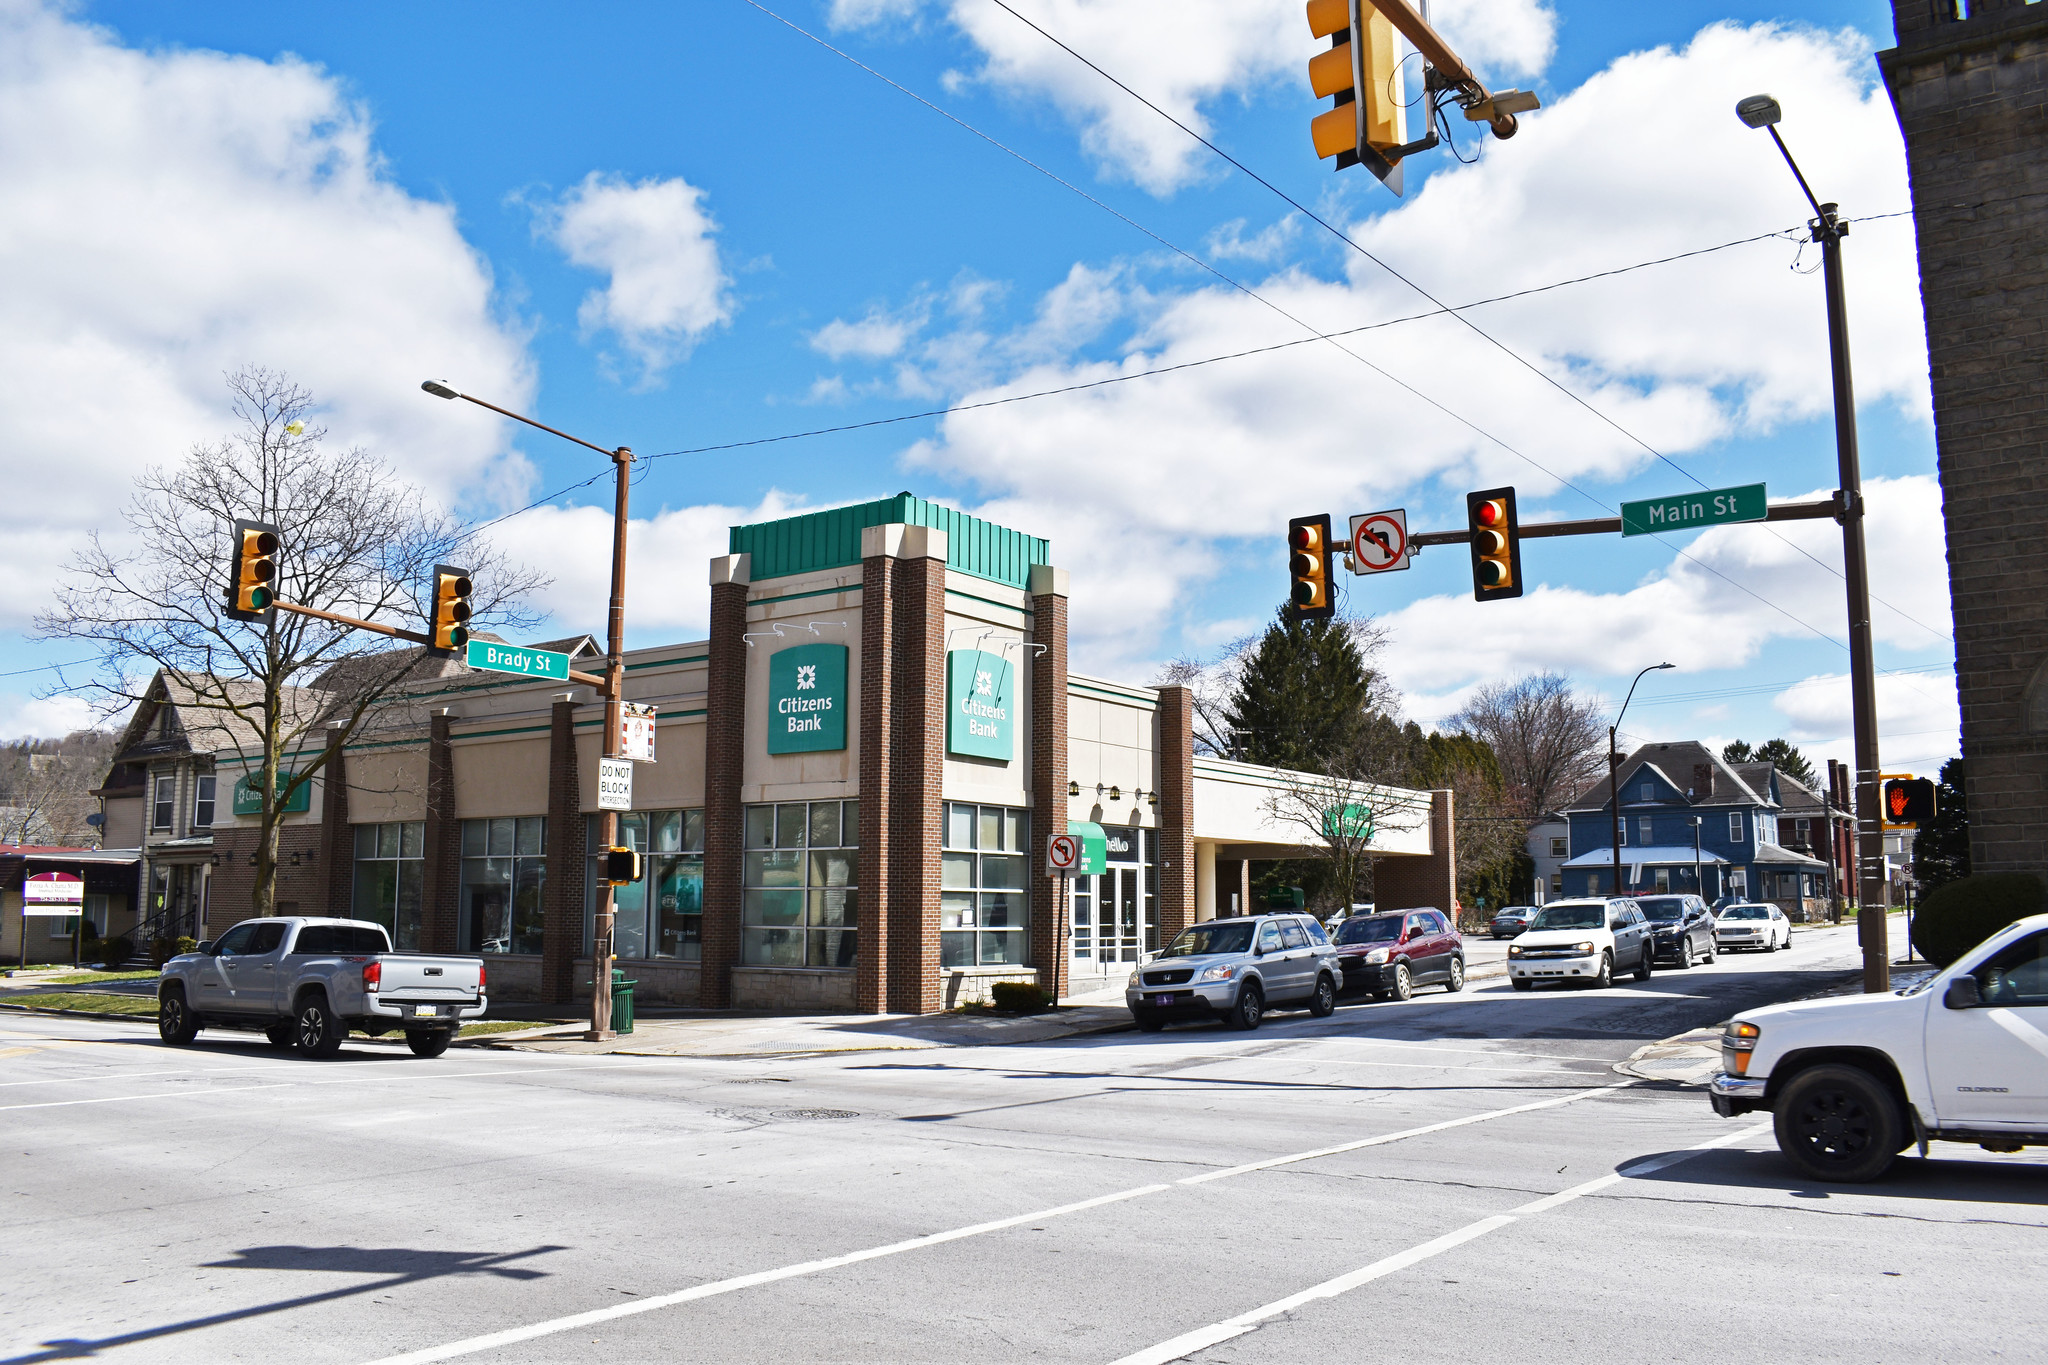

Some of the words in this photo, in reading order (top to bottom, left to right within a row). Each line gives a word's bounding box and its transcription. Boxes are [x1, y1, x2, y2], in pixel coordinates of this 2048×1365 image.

[1649, 500, 1704, 525] Main
[1713, 495, 1737, 516] St
[487, 647, 531, 672] Brady
[536, 655, 551, 671] St
[778, 696, 833, 714] Citizens
[961, 697, 1006, 721] Citizens
[787, 714, 822, 733] Bank
[969, 718, 998, 739] Bank
[601, 765, 613, 777] DO
[614, 767, 630, 779] NOT
[601, 781, 629, 794] BLOCK
[1105, 835, 1129, 852] hello
